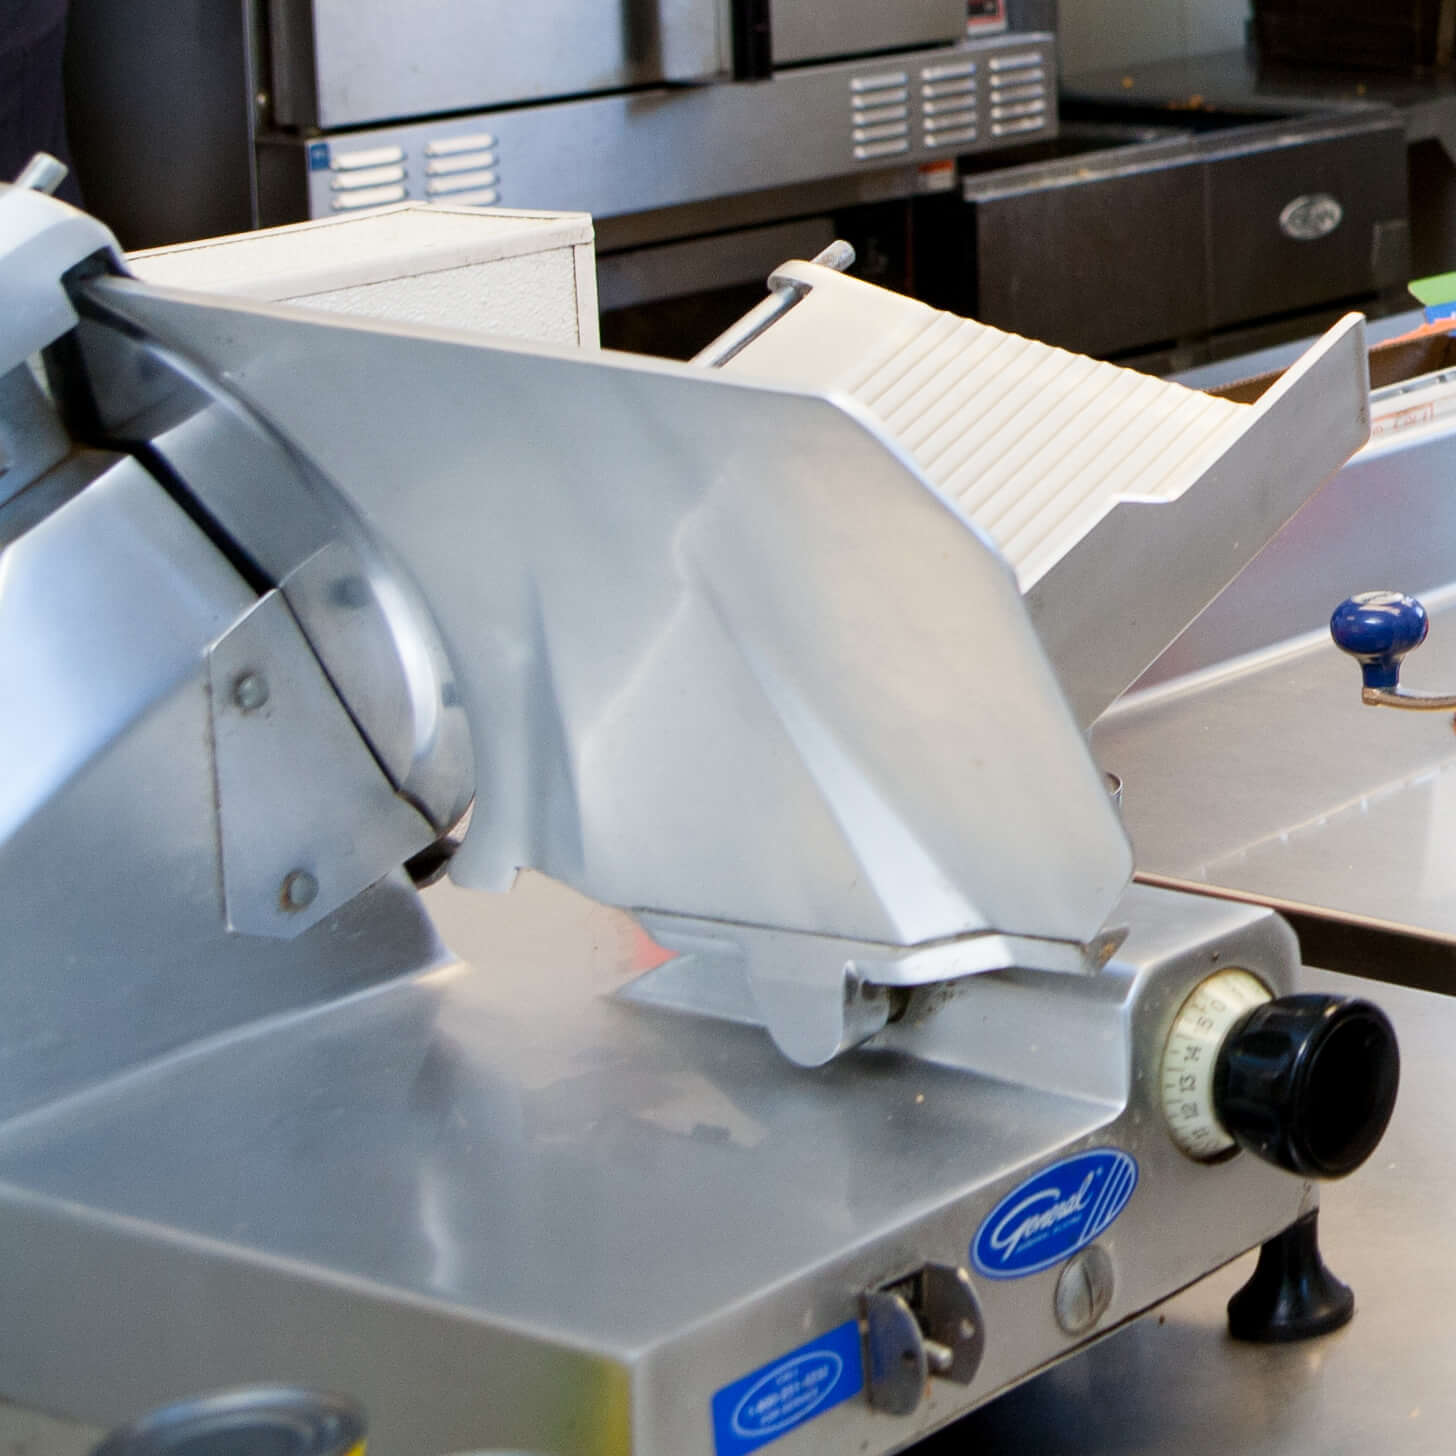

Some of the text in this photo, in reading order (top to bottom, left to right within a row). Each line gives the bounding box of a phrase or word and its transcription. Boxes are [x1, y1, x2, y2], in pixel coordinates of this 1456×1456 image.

[1179, 1073, 1196, 1093] 13
[1180, 1101, 1199, 1120] 12
[990, 1170, 1094, 1262] General
